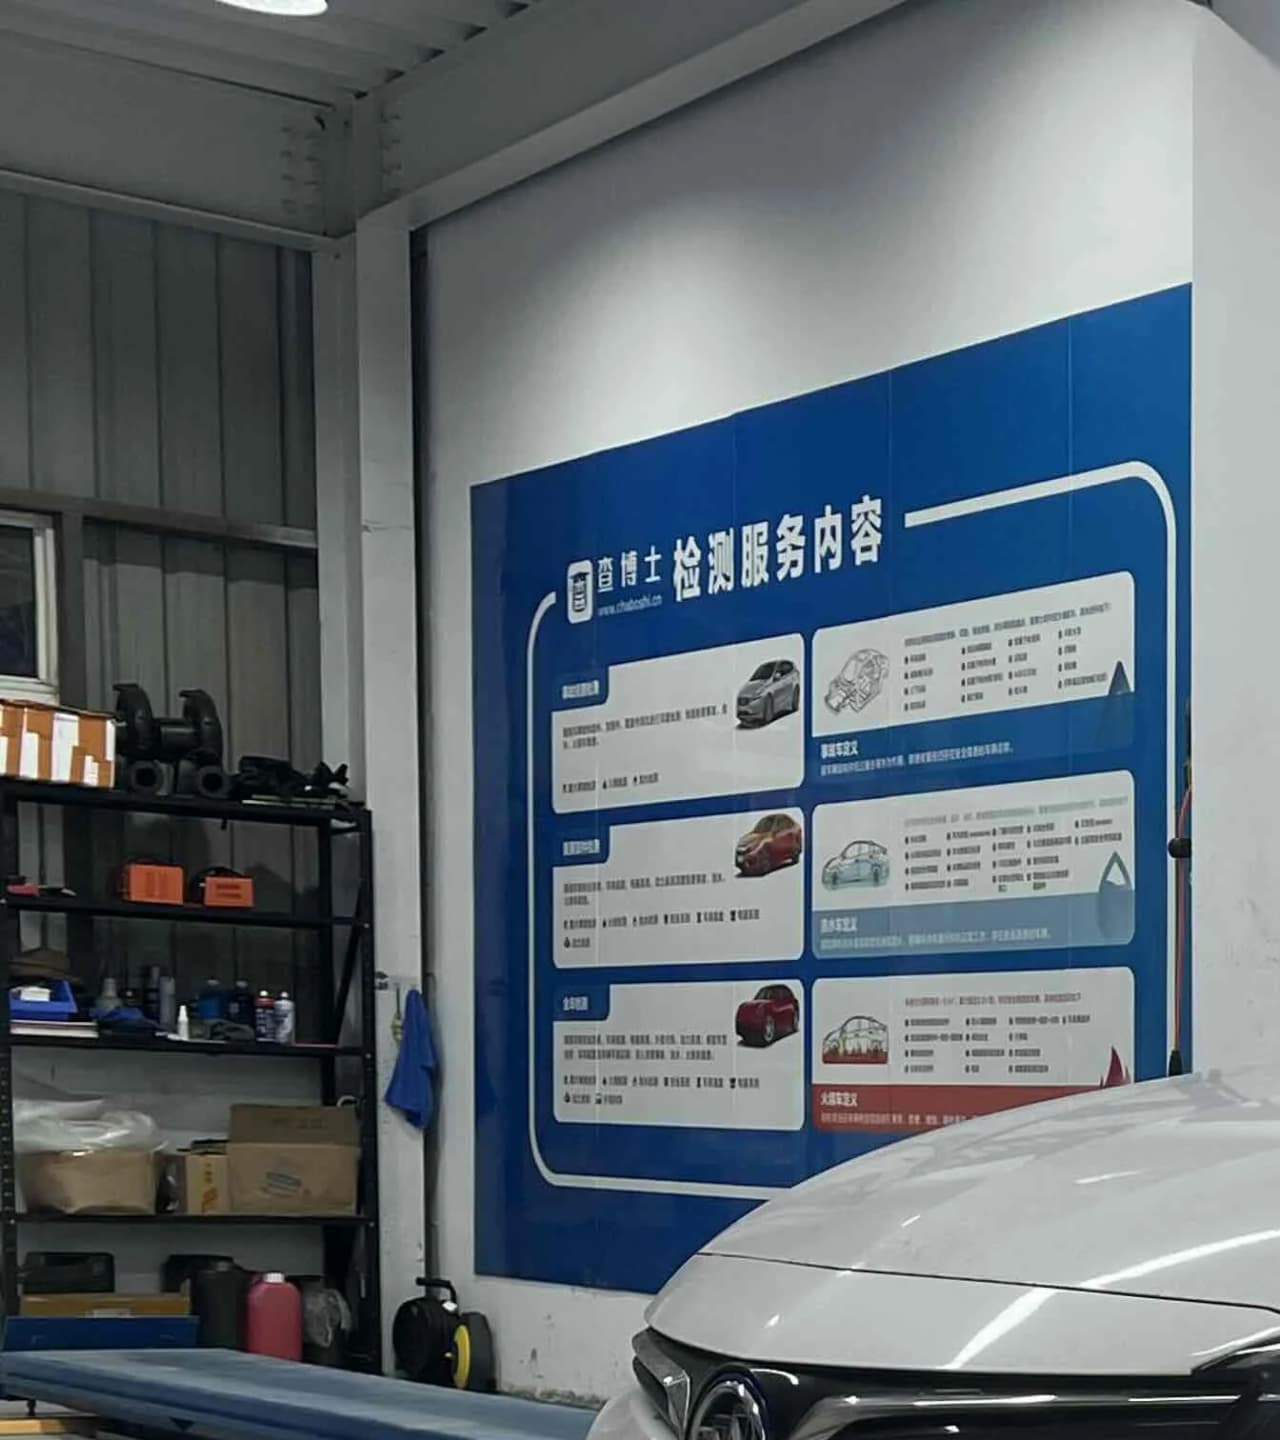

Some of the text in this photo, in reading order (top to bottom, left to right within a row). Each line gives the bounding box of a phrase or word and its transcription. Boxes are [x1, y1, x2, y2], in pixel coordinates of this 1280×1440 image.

[598, 495, 882, 601] 查博士 检测服务内容
